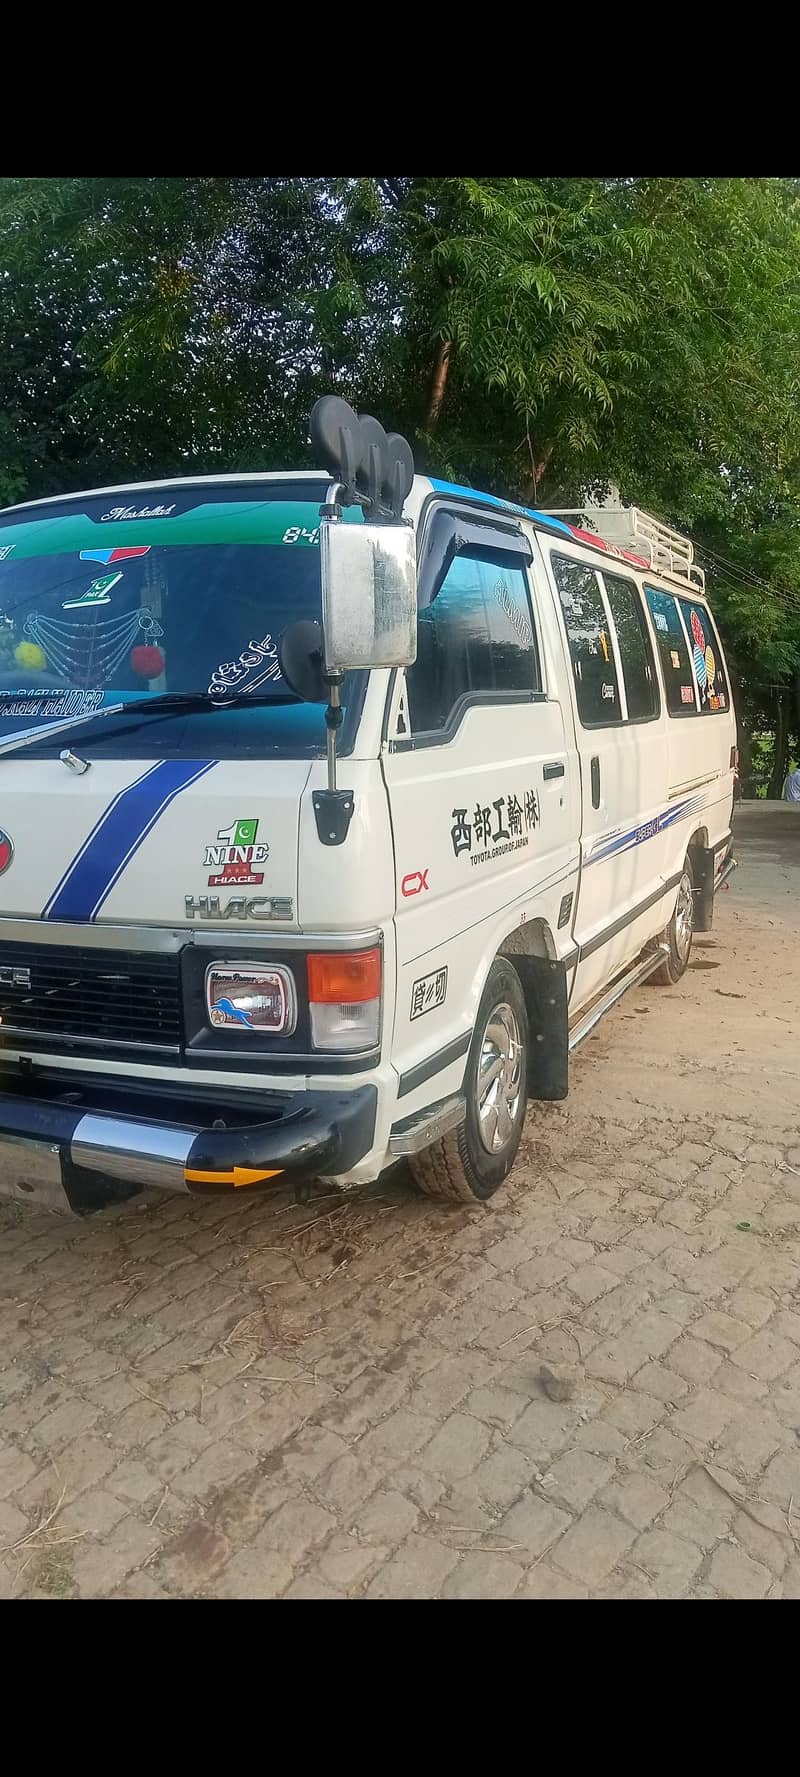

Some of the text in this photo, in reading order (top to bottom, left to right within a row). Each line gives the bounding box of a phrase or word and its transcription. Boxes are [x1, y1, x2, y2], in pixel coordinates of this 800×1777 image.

[203, 843, 269, 866] NINE
[214, 875, 257, 884] HIACE
[401, 869, 429, 897] CX
[185, 895, 293, 920] HIACE
